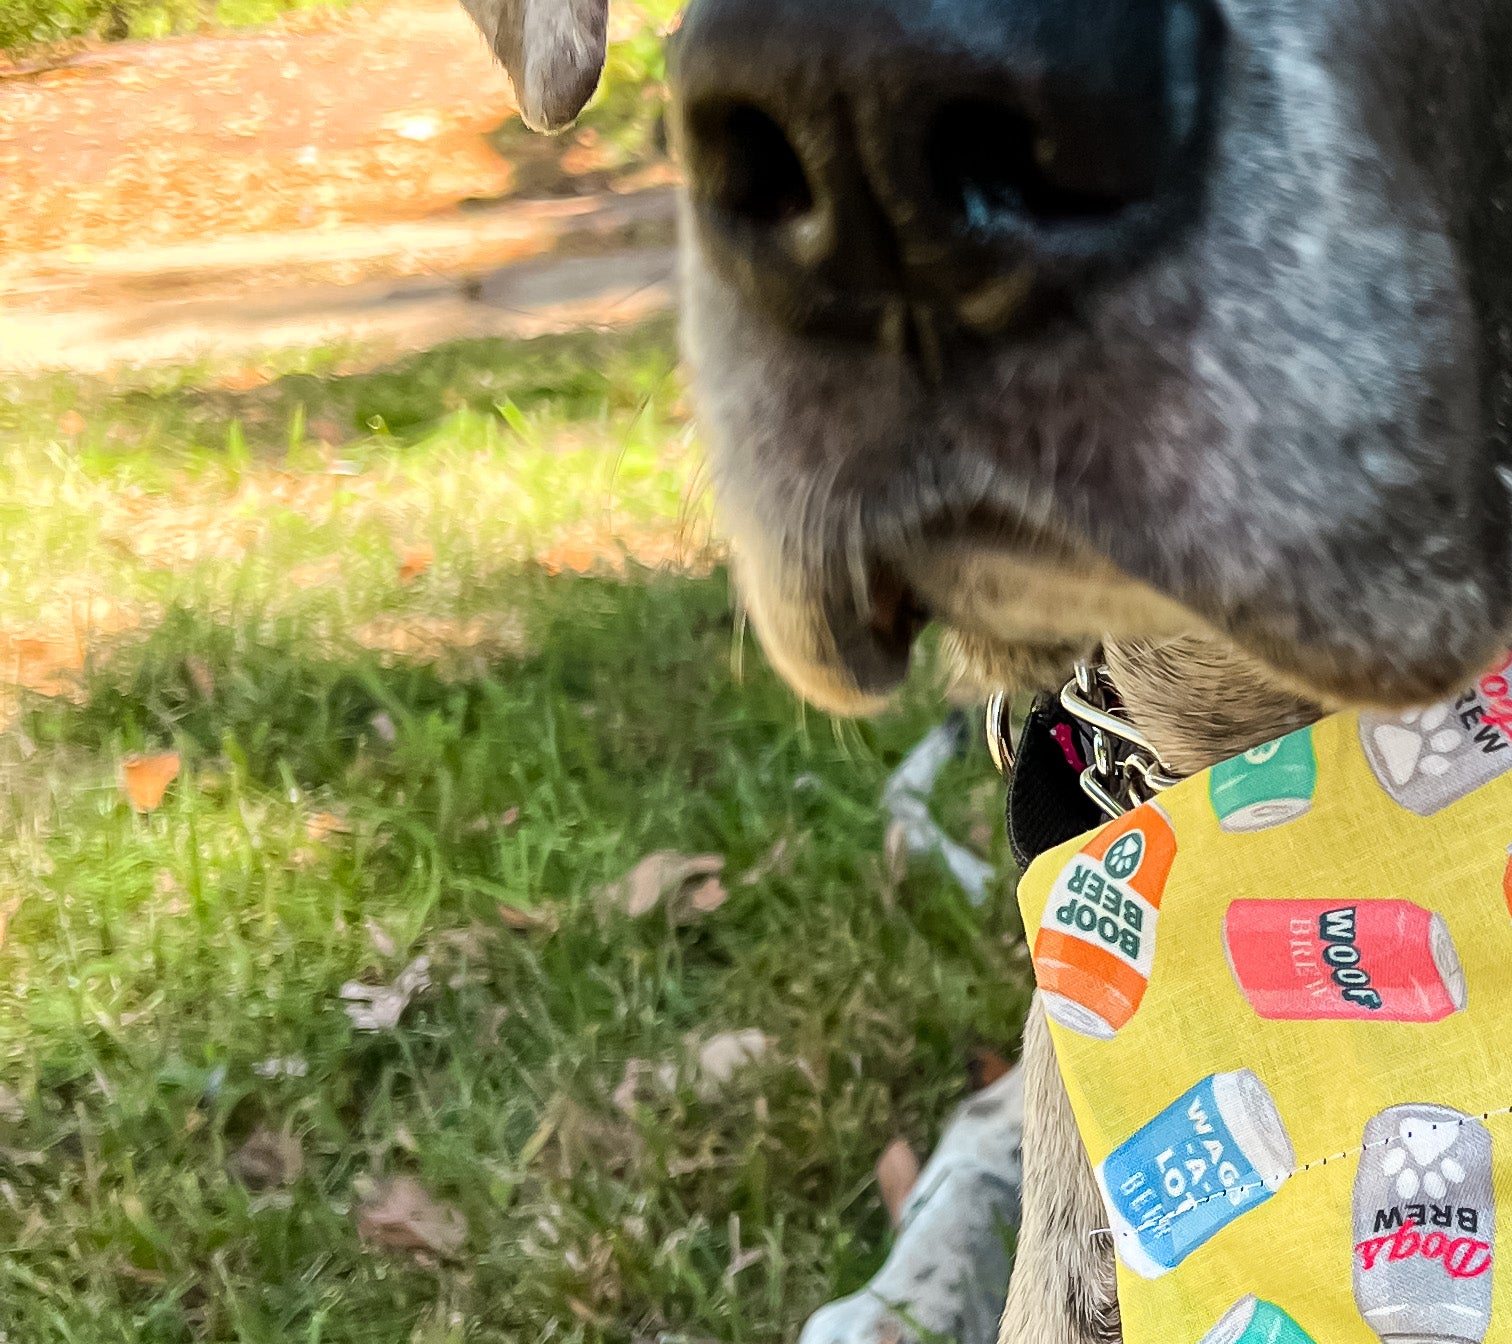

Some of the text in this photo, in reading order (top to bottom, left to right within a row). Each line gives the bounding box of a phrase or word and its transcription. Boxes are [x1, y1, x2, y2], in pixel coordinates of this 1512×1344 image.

[1056, 899, 1141, 959] BOOP
[1067, 865, 1143, 932] BEER
[1319, 905, 1383, 1010] WOOF
[1155, 1147, 1197, 1214] LOT
[1354, 1218, 1492, 1279] Dogs
[1373, 1204, 1478, 1233] BREW
